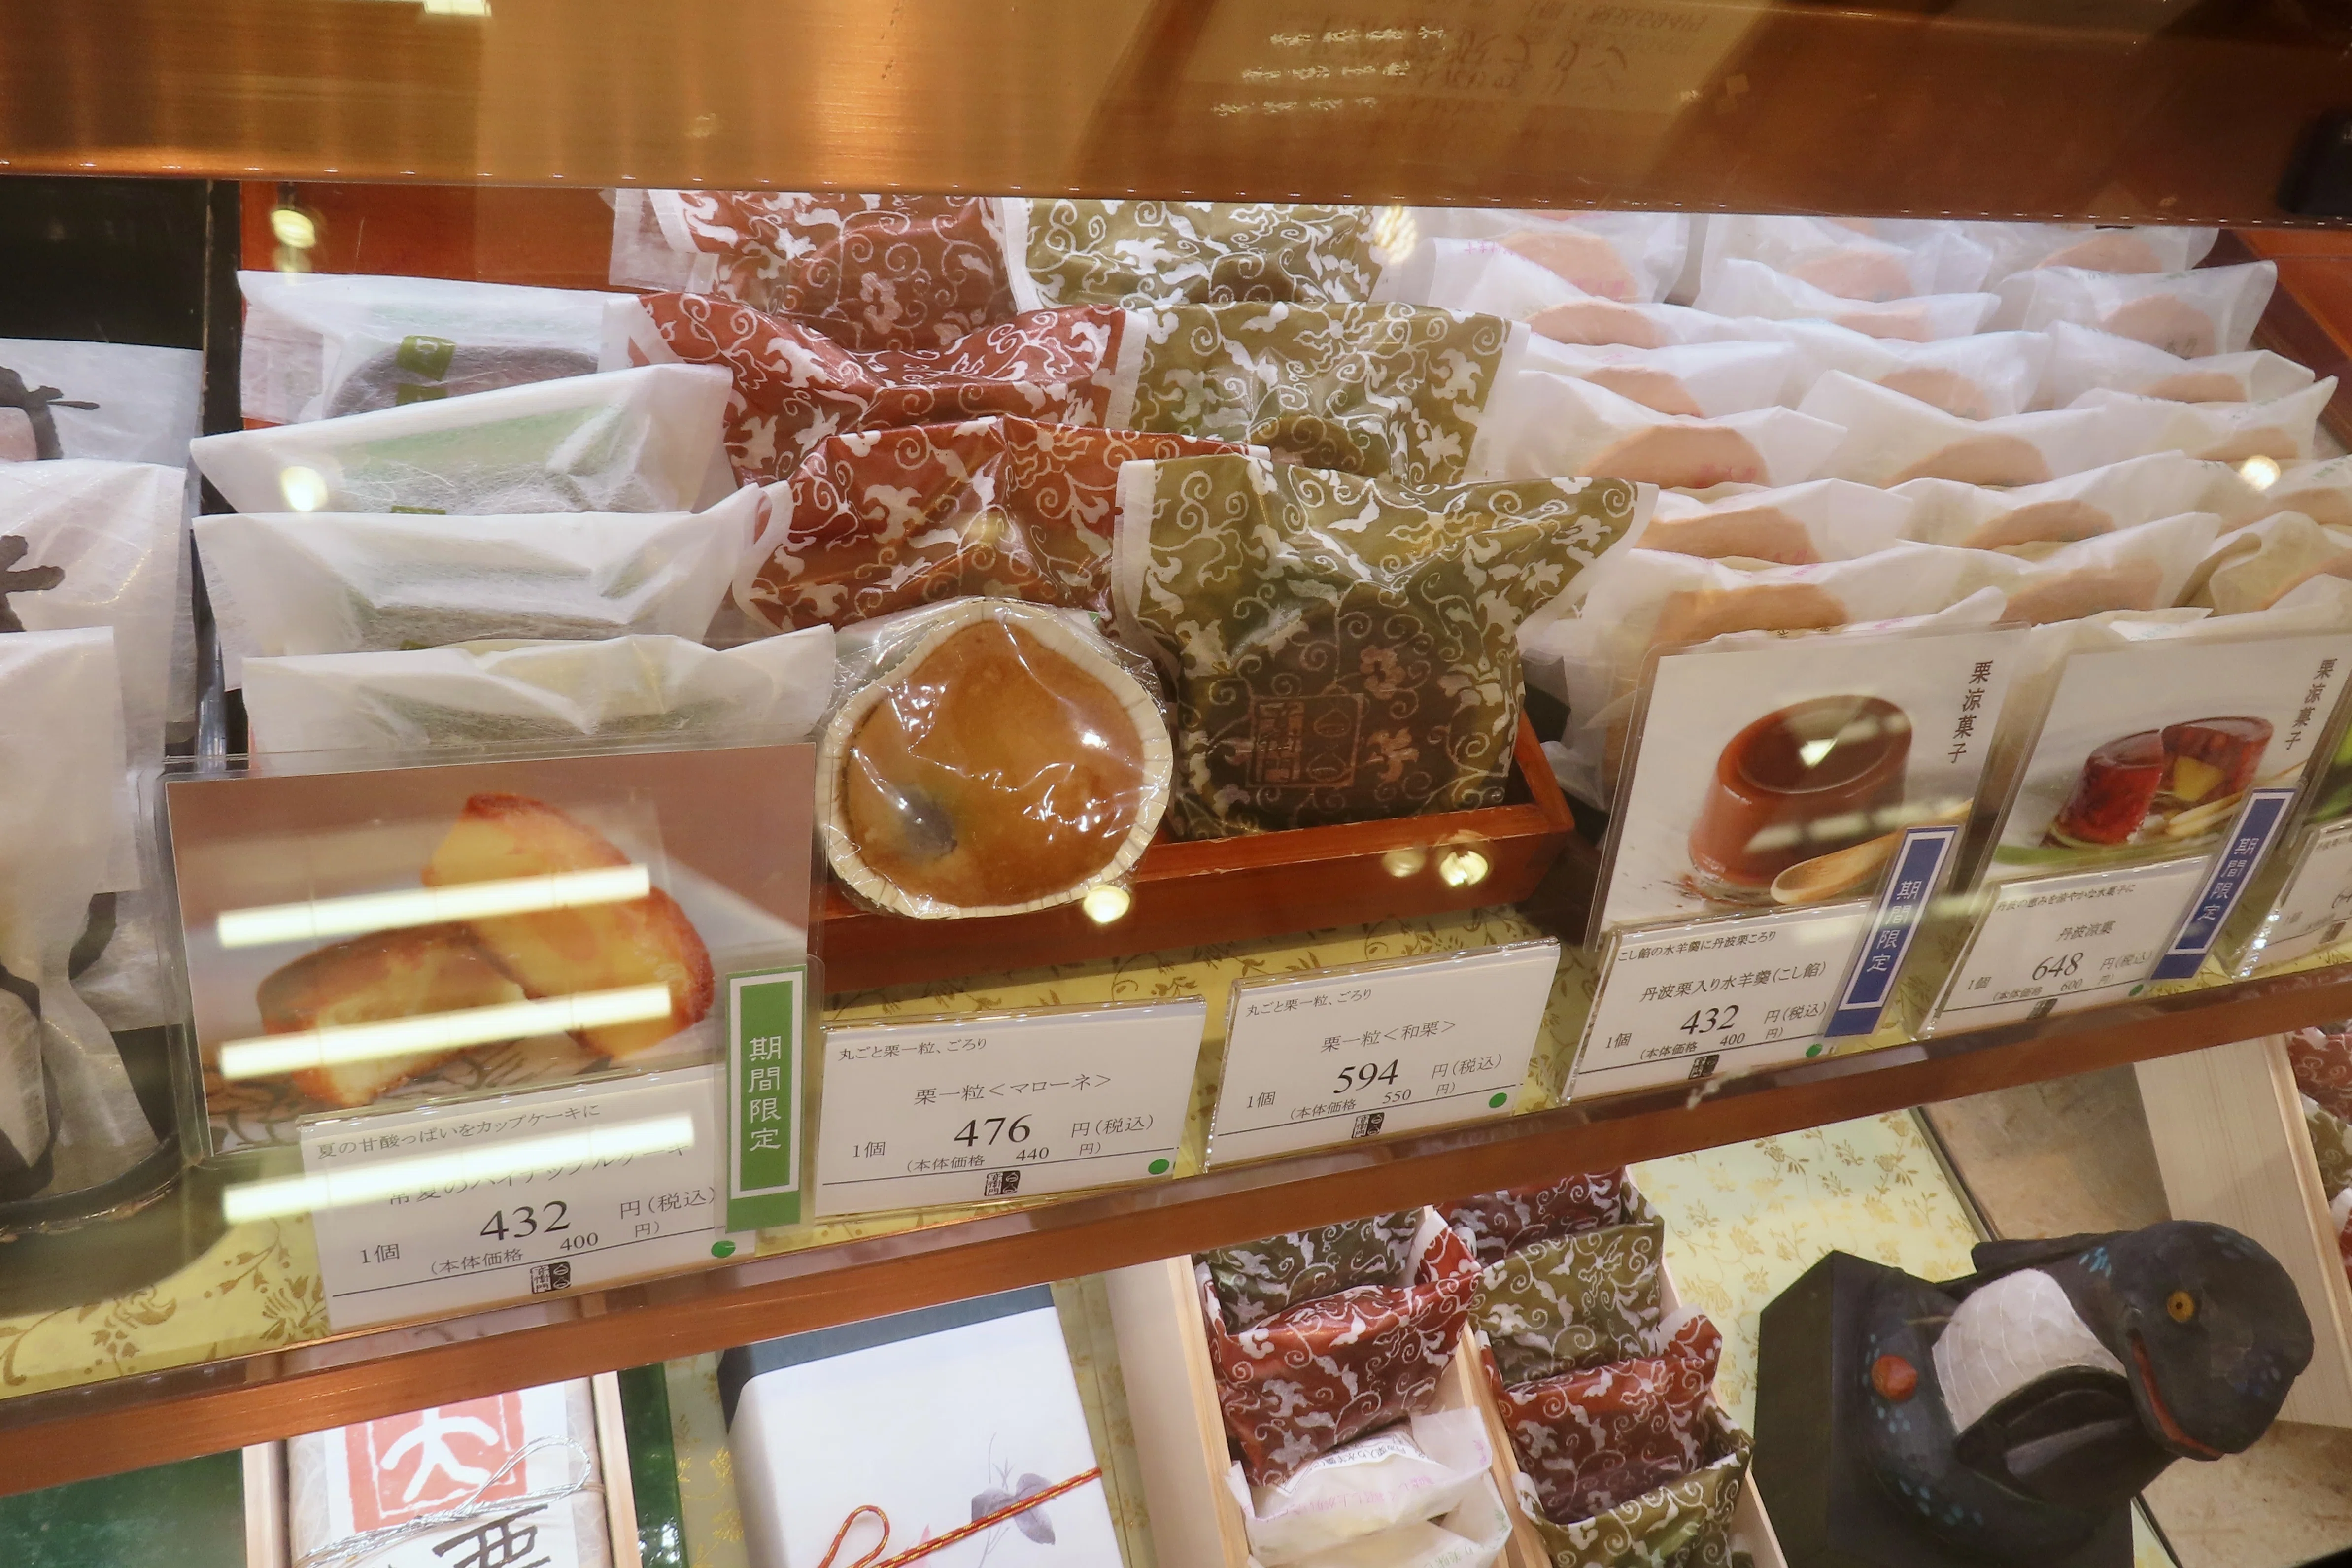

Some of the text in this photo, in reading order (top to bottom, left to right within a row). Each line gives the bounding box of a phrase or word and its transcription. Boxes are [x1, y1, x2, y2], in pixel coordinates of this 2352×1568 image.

[1947, 660, 1993, 764] 栗涼菓子
[2197, 838, 2259, 921] 期間限定
[1867, 880, 1921, 973] 期間限定
[2032, 952, 2083, 981] 648
[2060, 978, 2082, 991] 600
[1681, 1005, 1739, 1035] 432
[839, 1038, 987, 1061] 丸ごと栗一粒、ごろり
[1605, 1032, 1632, 1049] 1個
[1719, 1032, 1745, 1046] 400
[1333, 1059, 1399, 1093] 594
[749, 1036, 781, 1151] 期間限定
[1247, 1092, 1276, 1108] 1個
[1383, 1089, 1412, 1104] 550
[318, 1104, 600, 1159] 夏の甘酸っぱいをカップケーキに
[954, 1114, 1031, 1147] 476
[853, 1142, 885, 1158] 1個
[1016, 1147, 1049, 1160] 440
[480, 1200, 571, 1241] 432
[361, 1243, 400, 1263] 1個
[559, 1232, 598, 1251] 400
